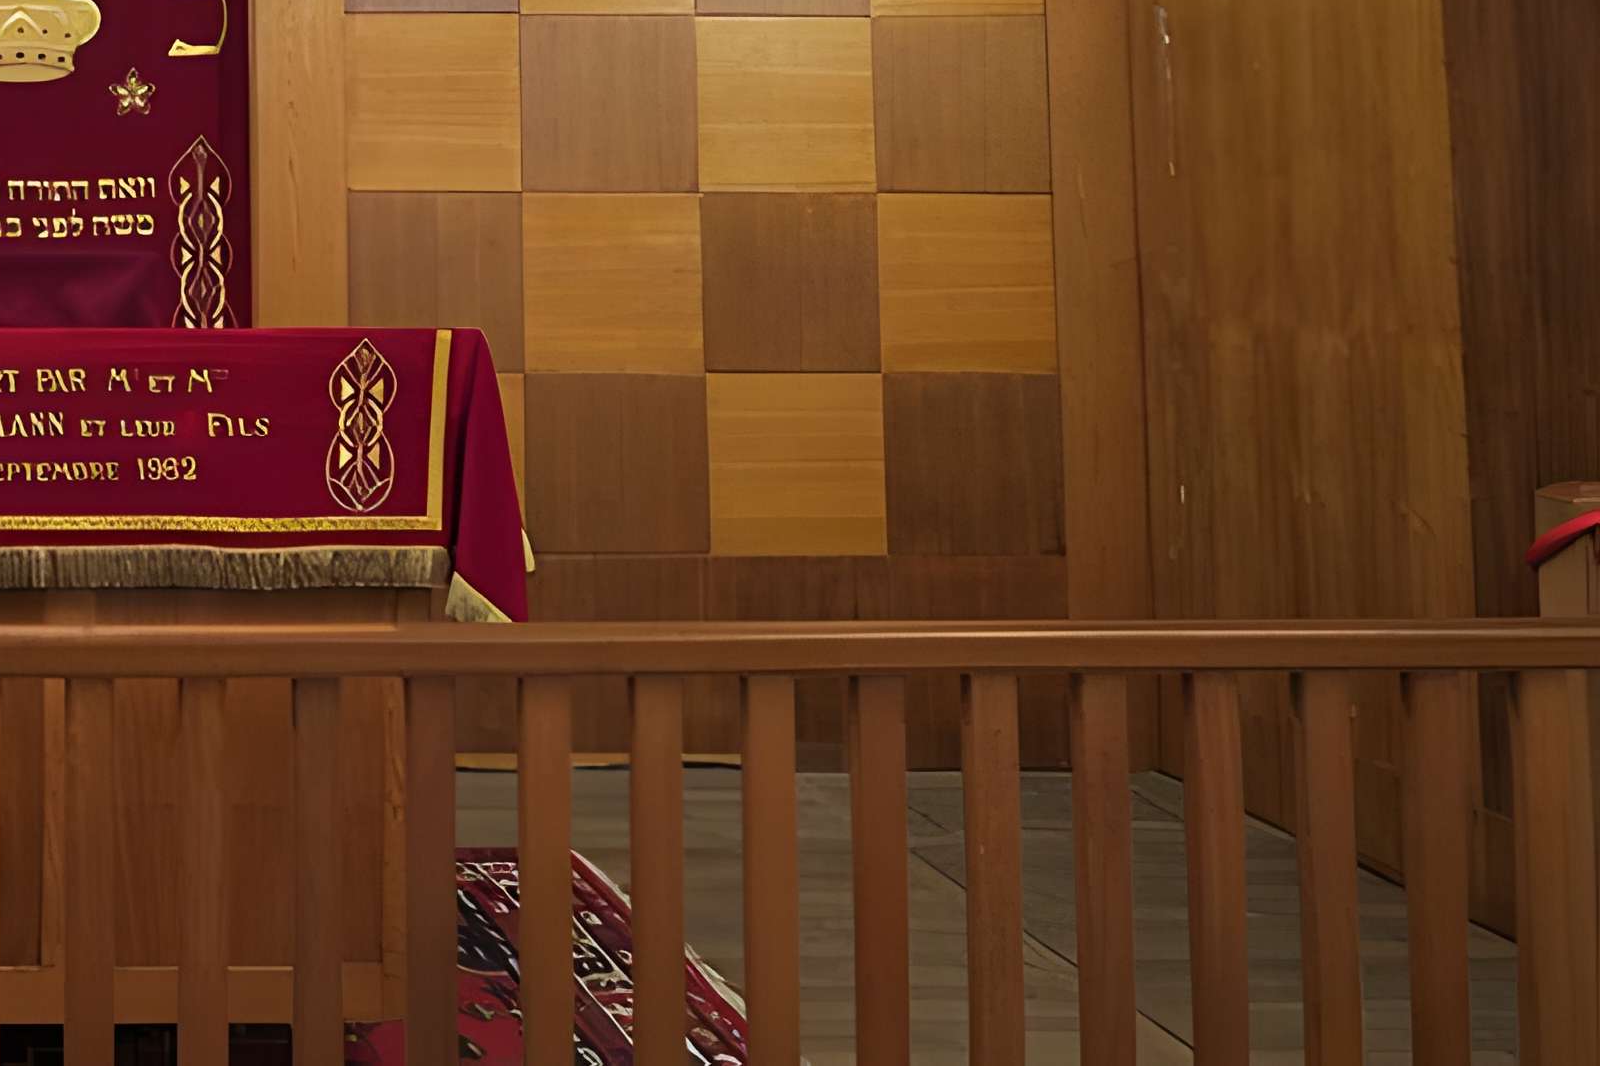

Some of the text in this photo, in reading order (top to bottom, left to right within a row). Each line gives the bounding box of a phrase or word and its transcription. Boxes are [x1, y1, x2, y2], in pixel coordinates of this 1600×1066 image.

[31, 208, 84, 239] לפני
[36, 368, 86, 393] PAR
[207, 412, 270, 438] FILS
